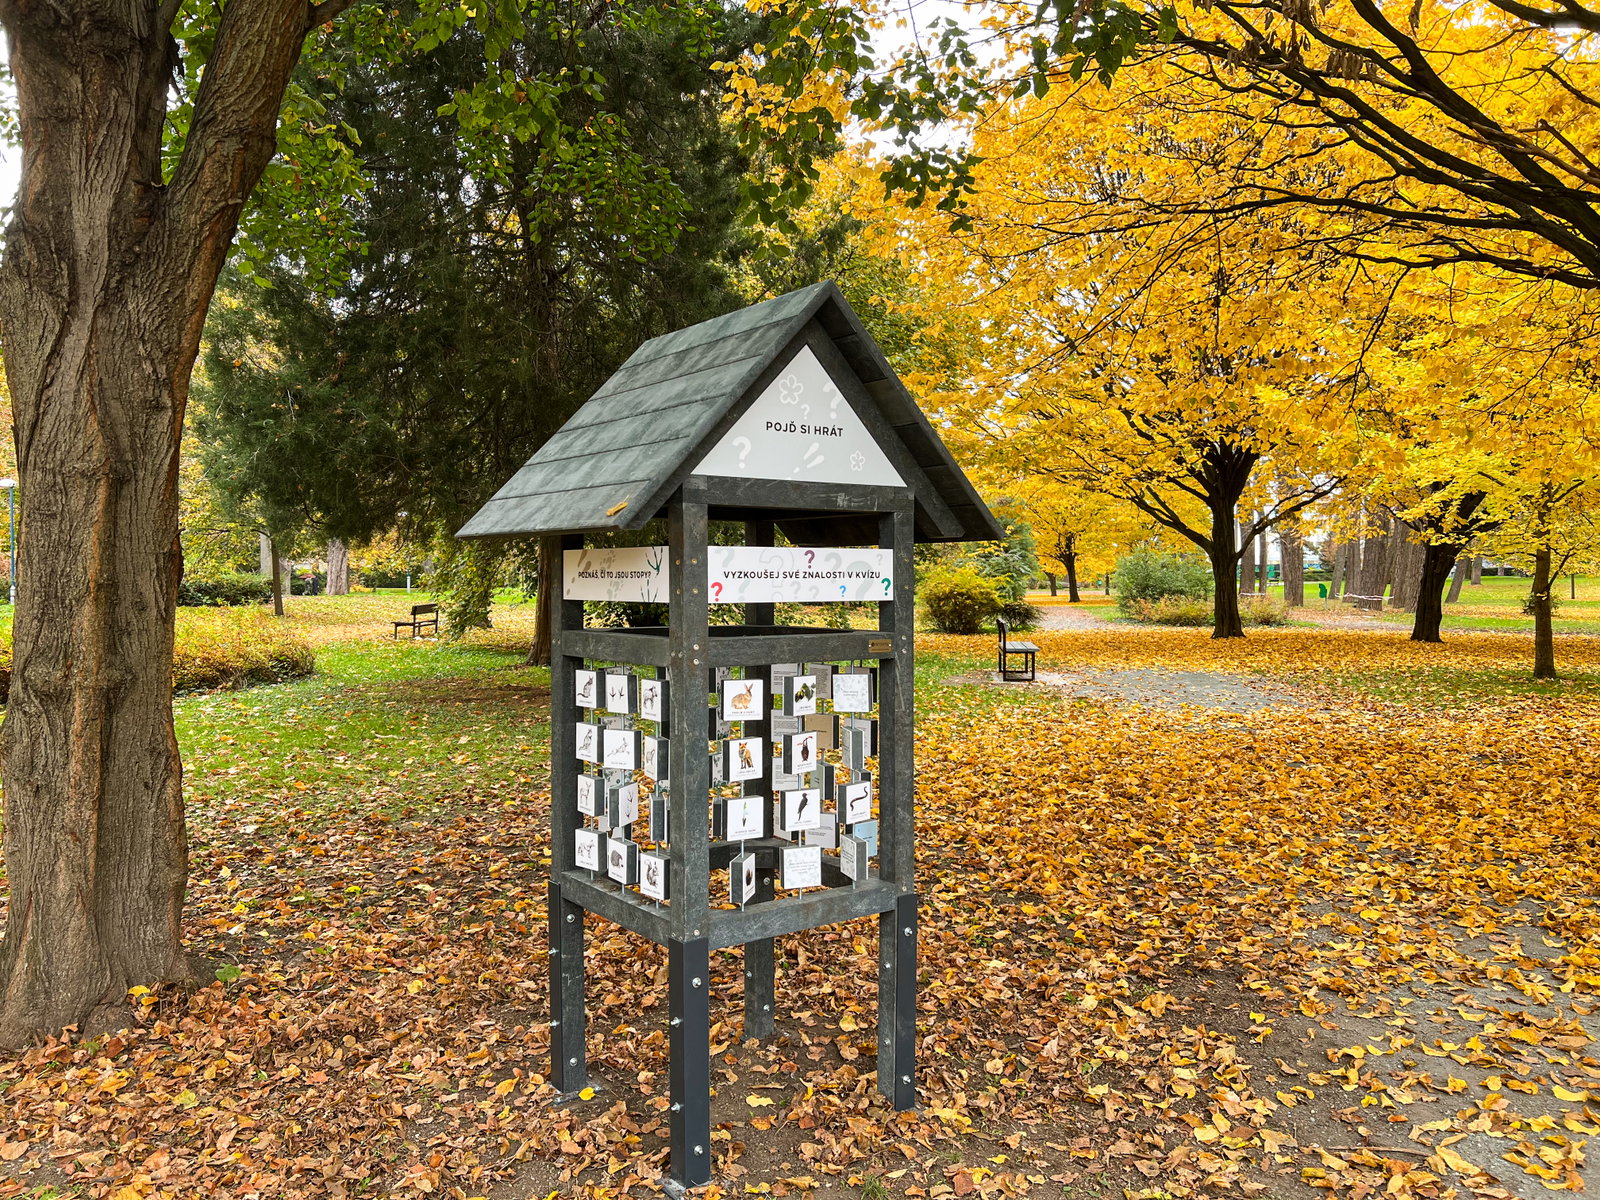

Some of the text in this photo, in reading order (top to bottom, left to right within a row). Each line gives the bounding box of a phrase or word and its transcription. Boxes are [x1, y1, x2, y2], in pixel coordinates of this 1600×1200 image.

[766, 420, 843, 437] POJĎ SI HRÁT
[578, 570, 599, 579] POZNÁŠ,
[606, 571, 614, 579] TO
[614, 571, 629, 579] JSOU
[630, 571, 652, 579] STOPY?
[723, 569, 881, 579] VYZKOUŠEJ SVÉ ZNALOSTI V KVÍZU
